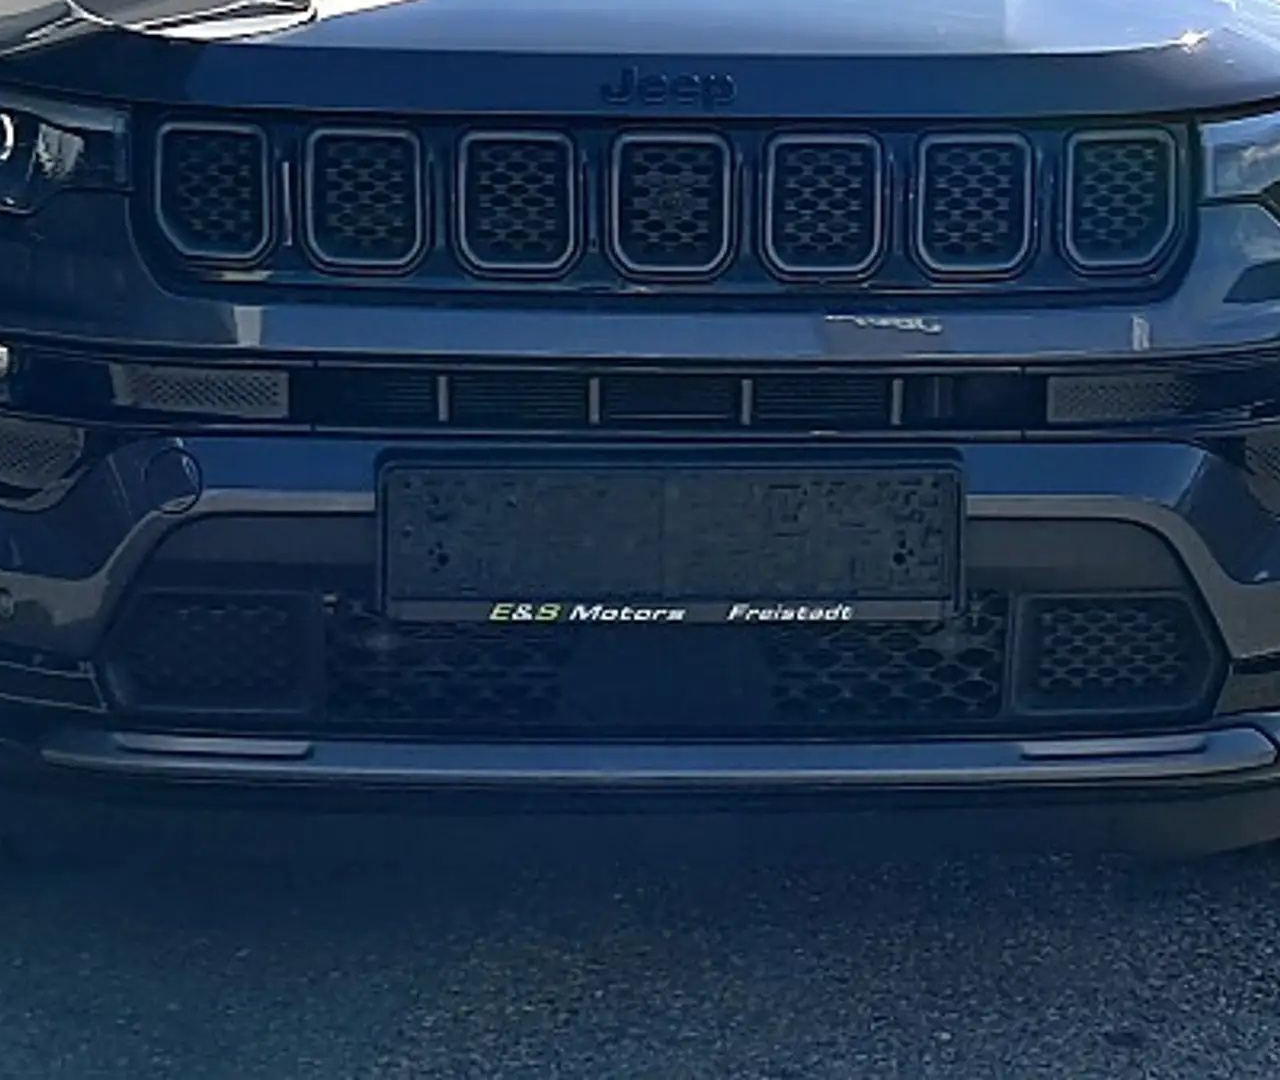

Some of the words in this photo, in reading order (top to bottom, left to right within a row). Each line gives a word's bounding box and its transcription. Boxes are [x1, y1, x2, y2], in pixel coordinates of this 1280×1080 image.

[600, 65, 737, 113] Jeep
[490, 602, 562, 621] E&S
[569, 603, 687, 621] Motors
[726, 603, 854, 621] Freistadt
